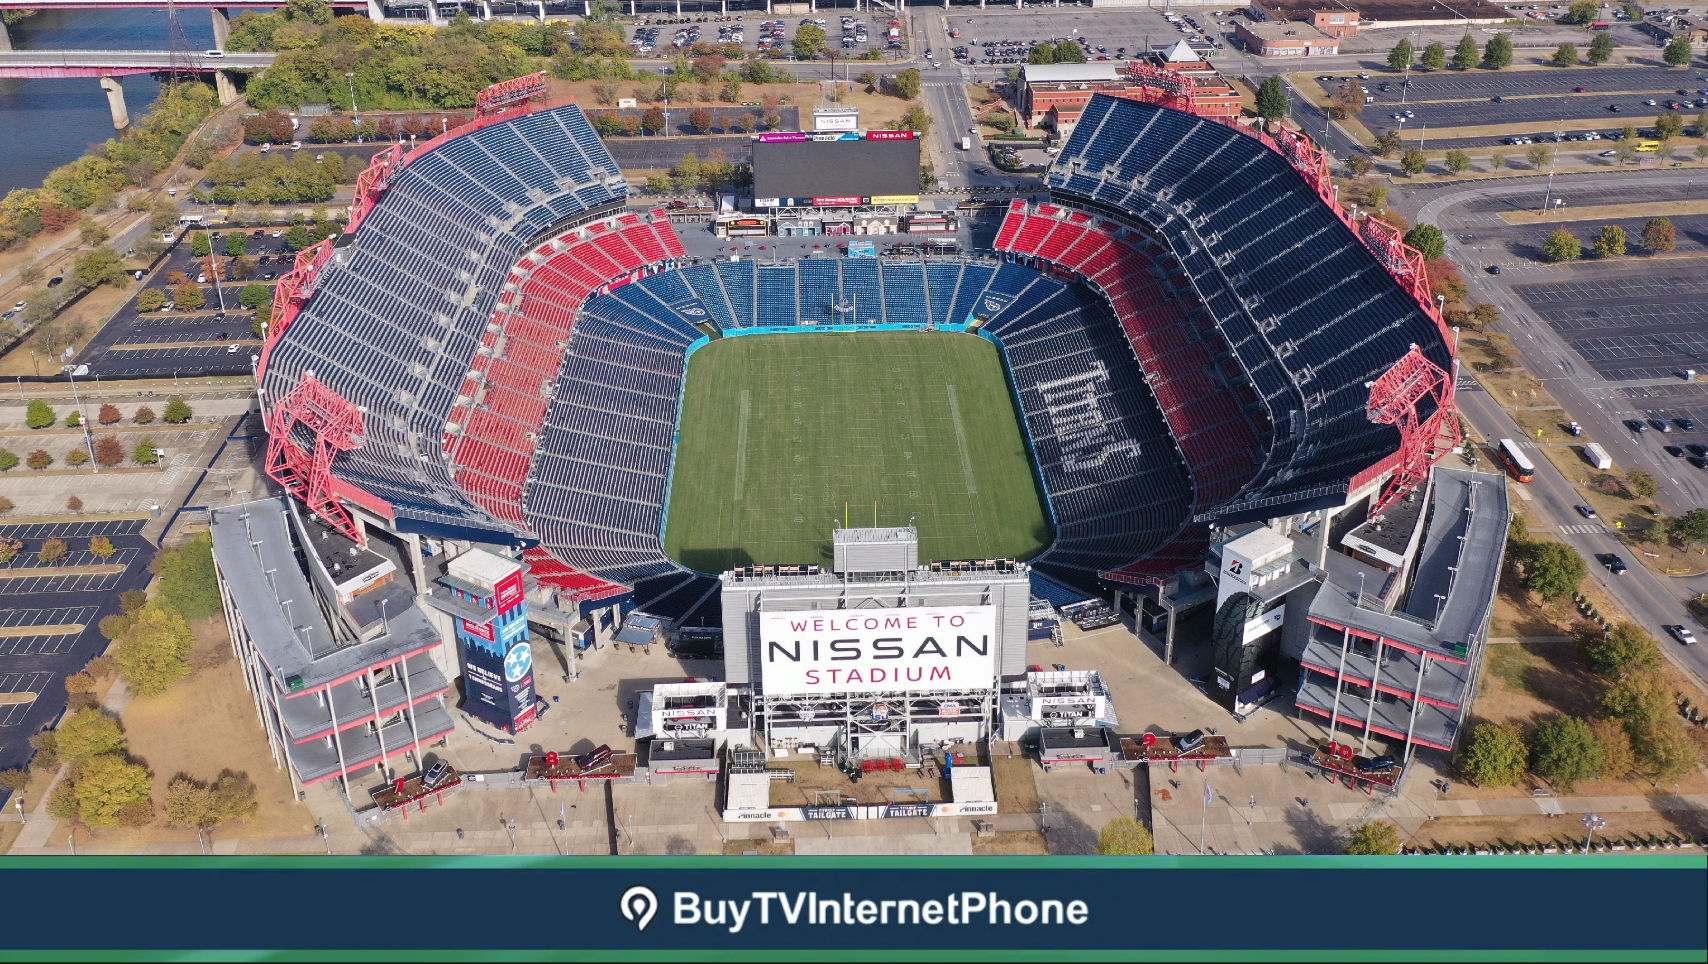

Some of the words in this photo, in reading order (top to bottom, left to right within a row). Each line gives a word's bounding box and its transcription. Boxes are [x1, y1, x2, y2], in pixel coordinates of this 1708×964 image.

[790, 616, 918, 632] WELCOME
[933, 615, 965, 628] TO
[768, 634, 988, 662] NISSAN
[806, 665, 951, 685] STADIUM
[662, 709, 716, 717] NISSAN
[1328, 741, 1354, 760] 10
[545, 751, 560, 767] 8
[392, 777, 406, 793] 7
[808, 811, 846, 819] TAILGATE
[889, 808, 928, 817] TAILGATE
